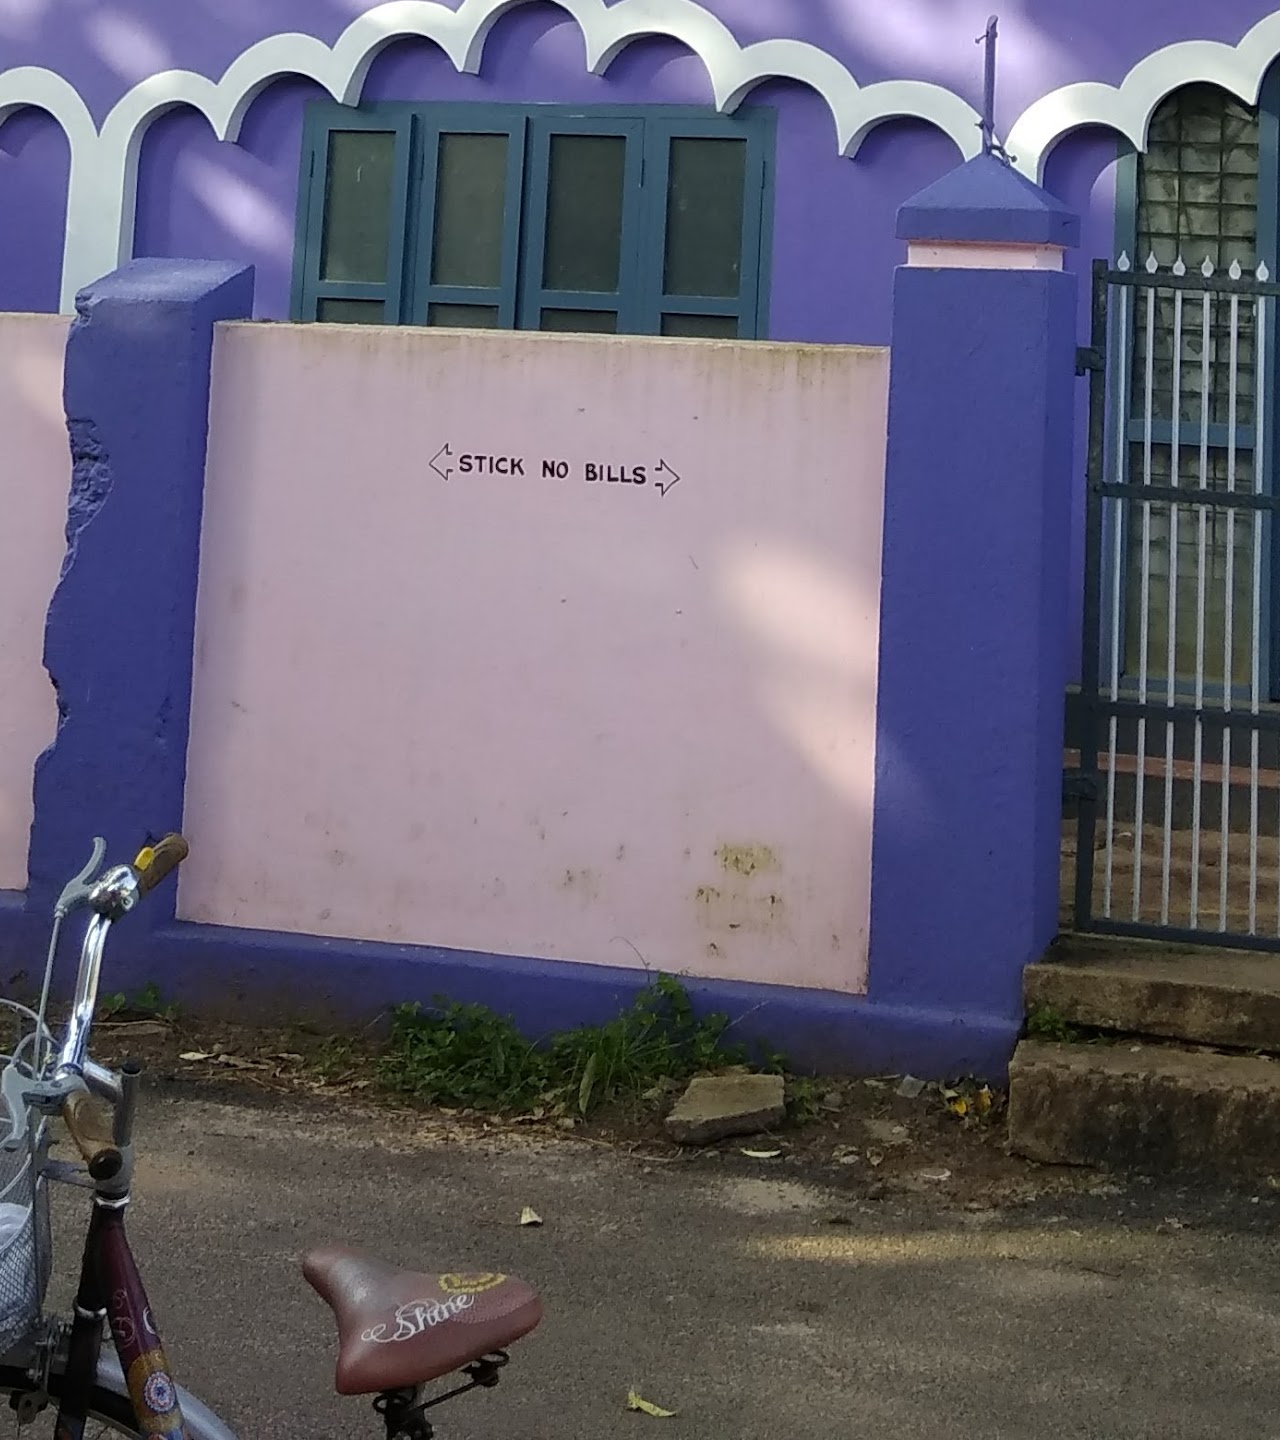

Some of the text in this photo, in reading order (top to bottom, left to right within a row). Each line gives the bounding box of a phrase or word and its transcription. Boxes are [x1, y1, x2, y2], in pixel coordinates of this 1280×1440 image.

[458, 454, 647, 485] STICK NO BILLS
